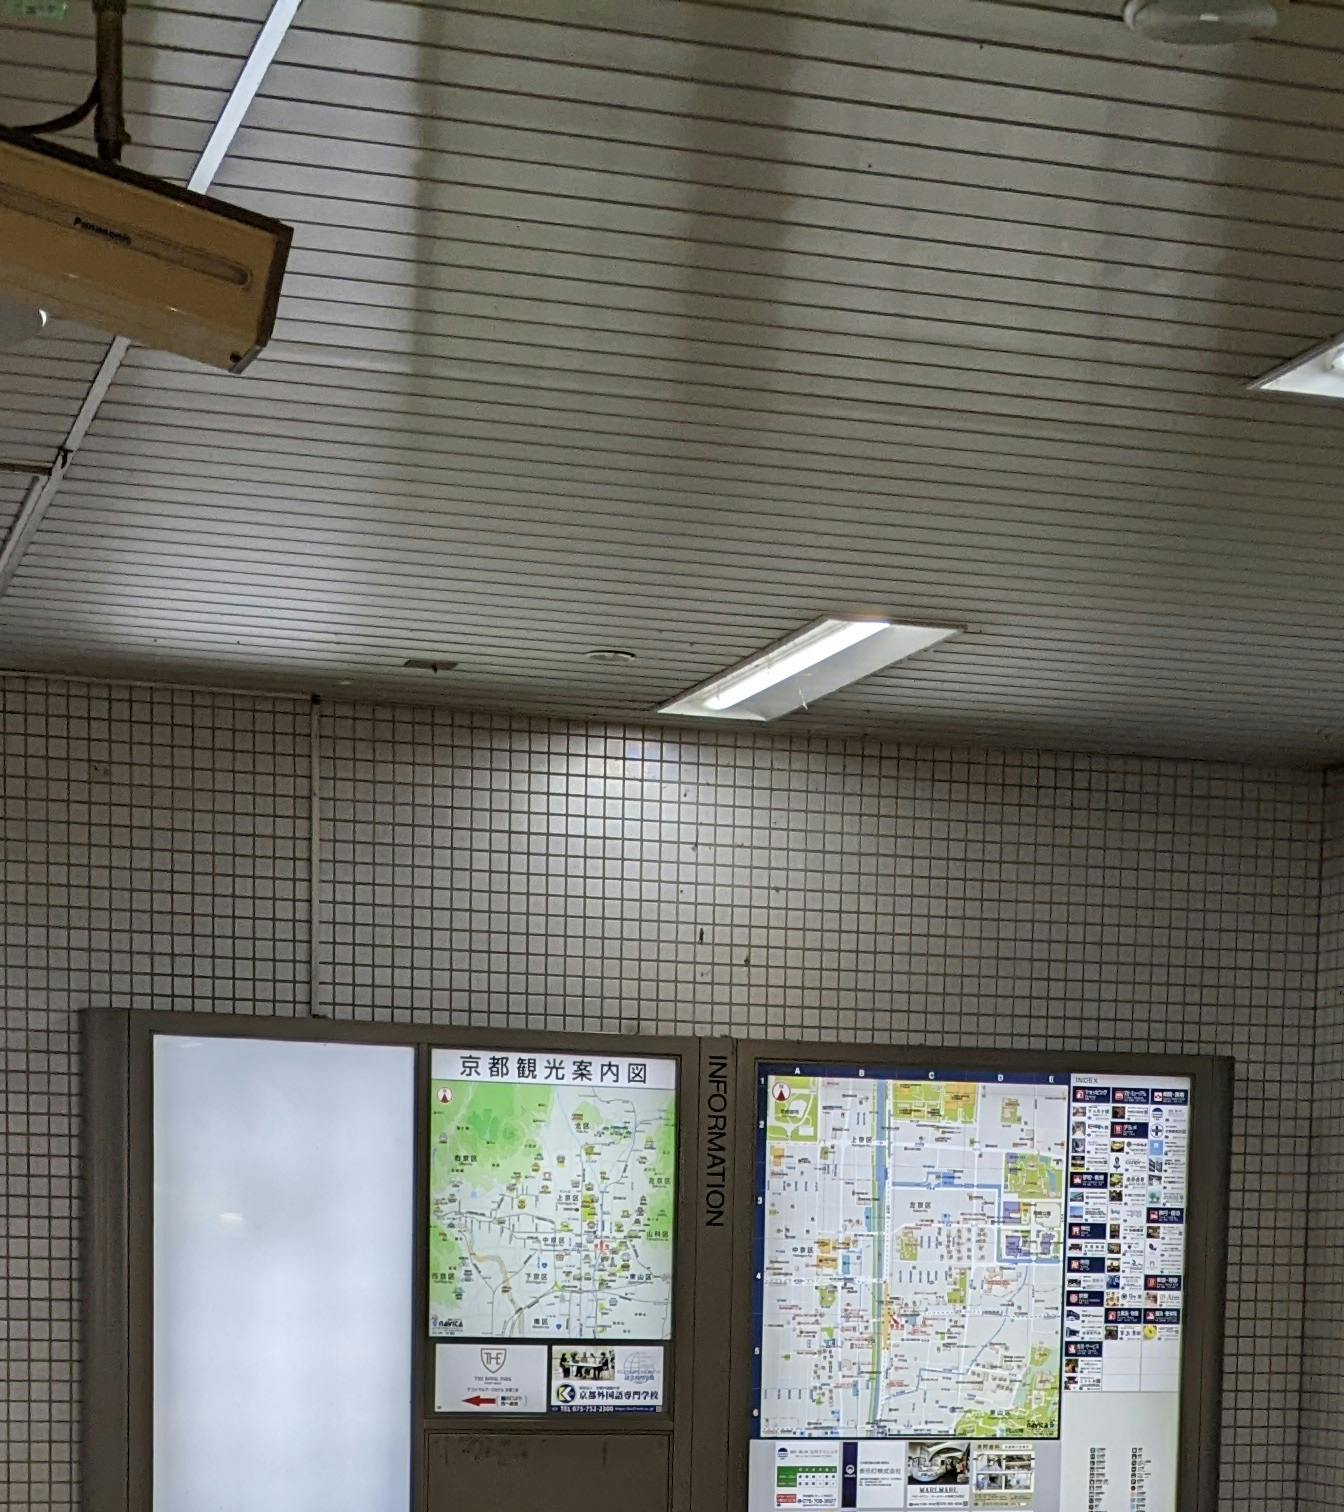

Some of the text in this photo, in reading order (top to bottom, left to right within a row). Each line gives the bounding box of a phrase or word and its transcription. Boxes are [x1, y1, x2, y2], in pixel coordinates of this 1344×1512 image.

[459, 1054, 647, 1084] 京都観光案内図
[705, 1055, 728, 1227] INFORMATION
[579, 1390, 659, 1401] 京都外国語専門学校
